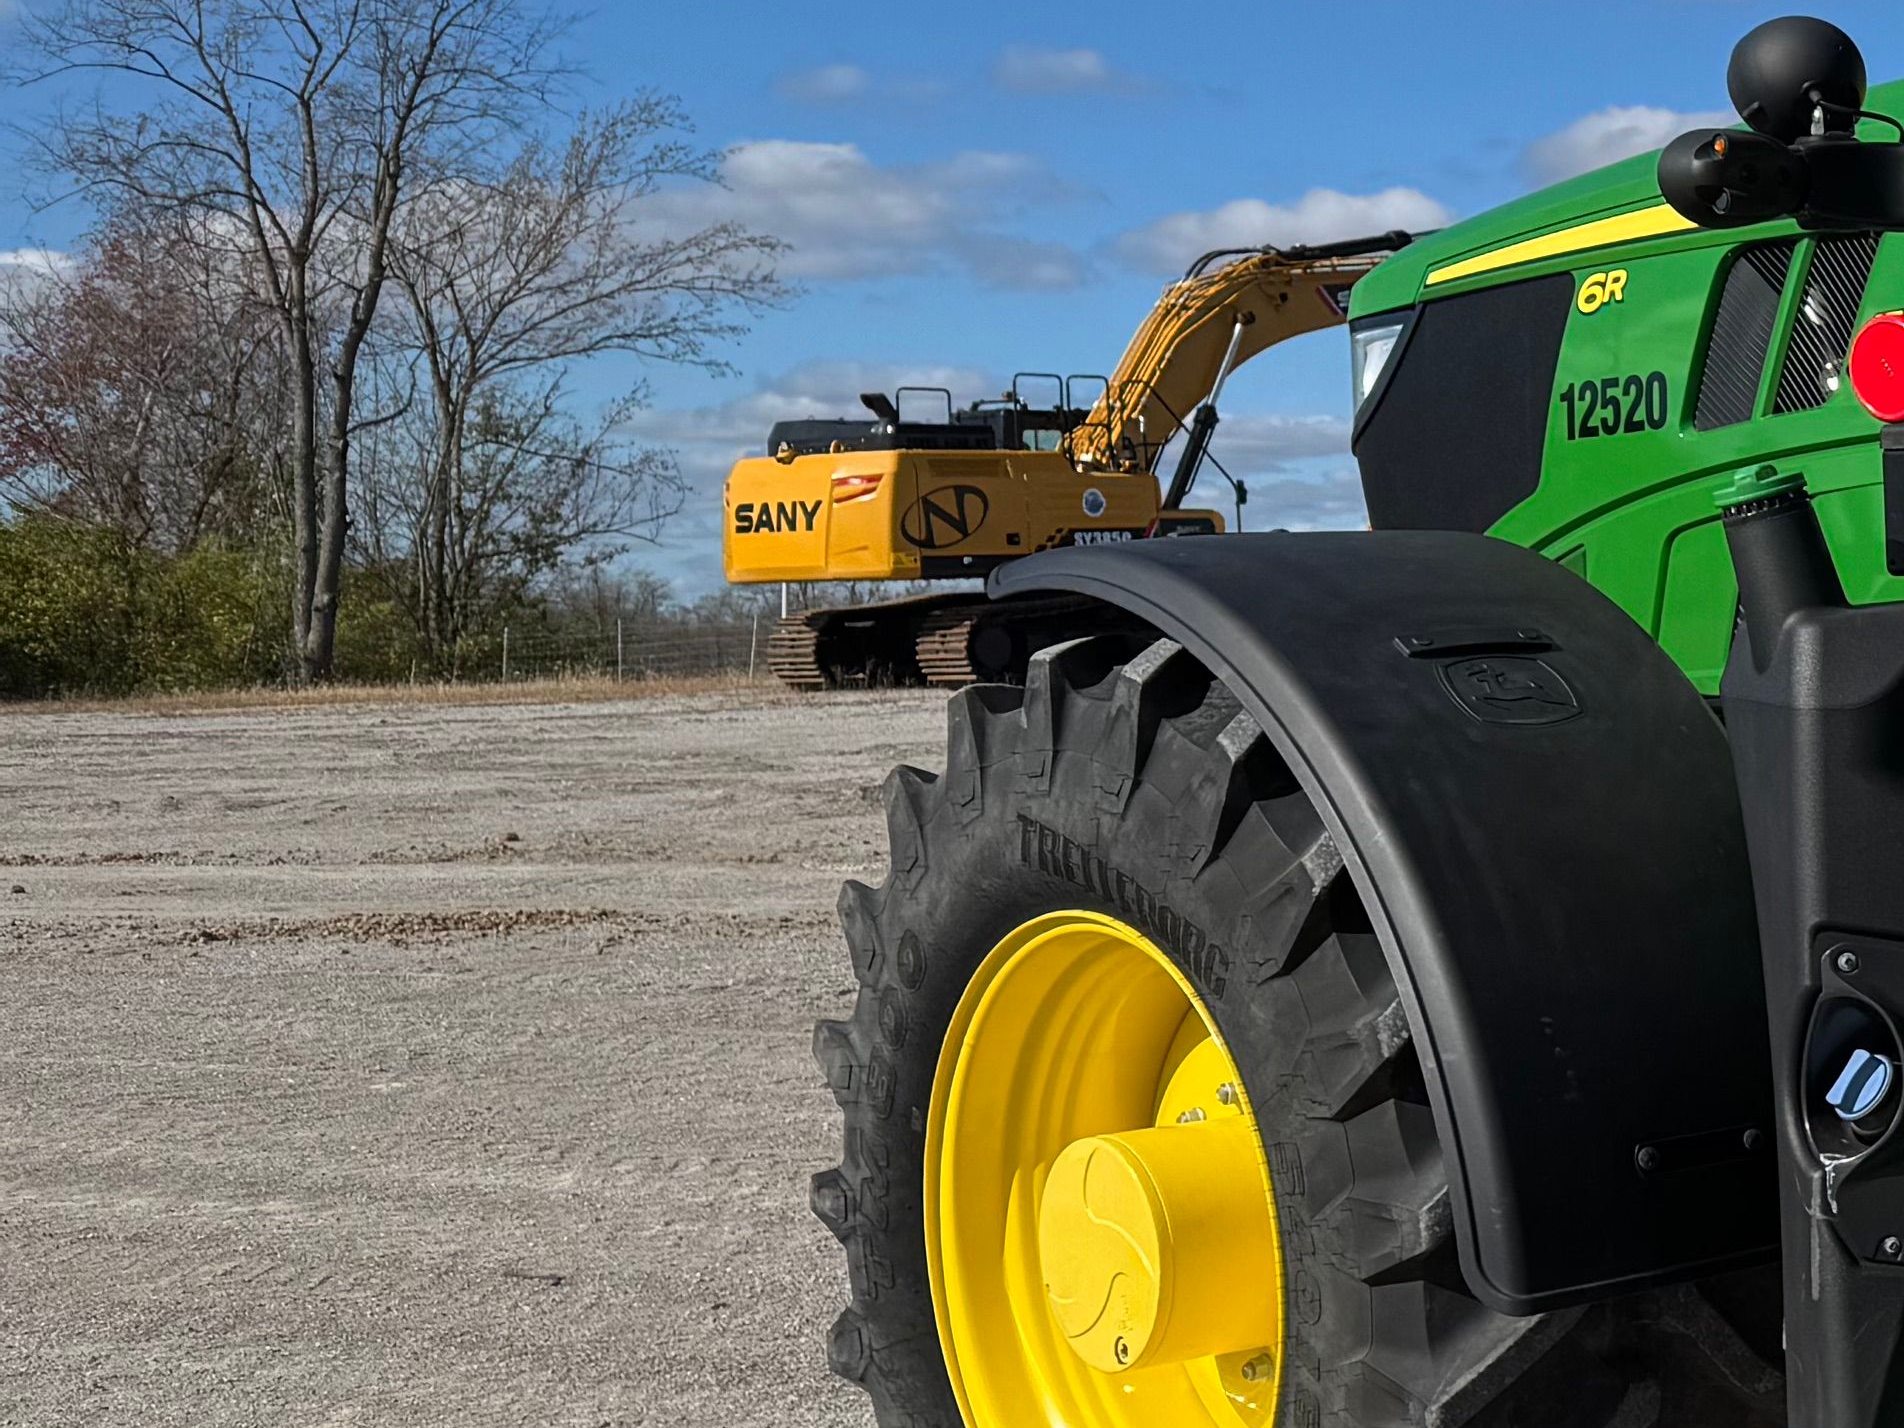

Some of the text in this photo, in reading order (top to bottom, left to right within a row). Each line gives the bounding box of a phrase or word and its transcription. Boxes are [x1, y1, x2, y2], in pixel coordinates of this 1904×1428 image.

[1577, 268, 1629, 315] 6R
[1559, 370, 1668, 441] 12520
[735, 500, 823, 534] SANY
[1014, 811, 1230, 1000] TRELLEBORG
